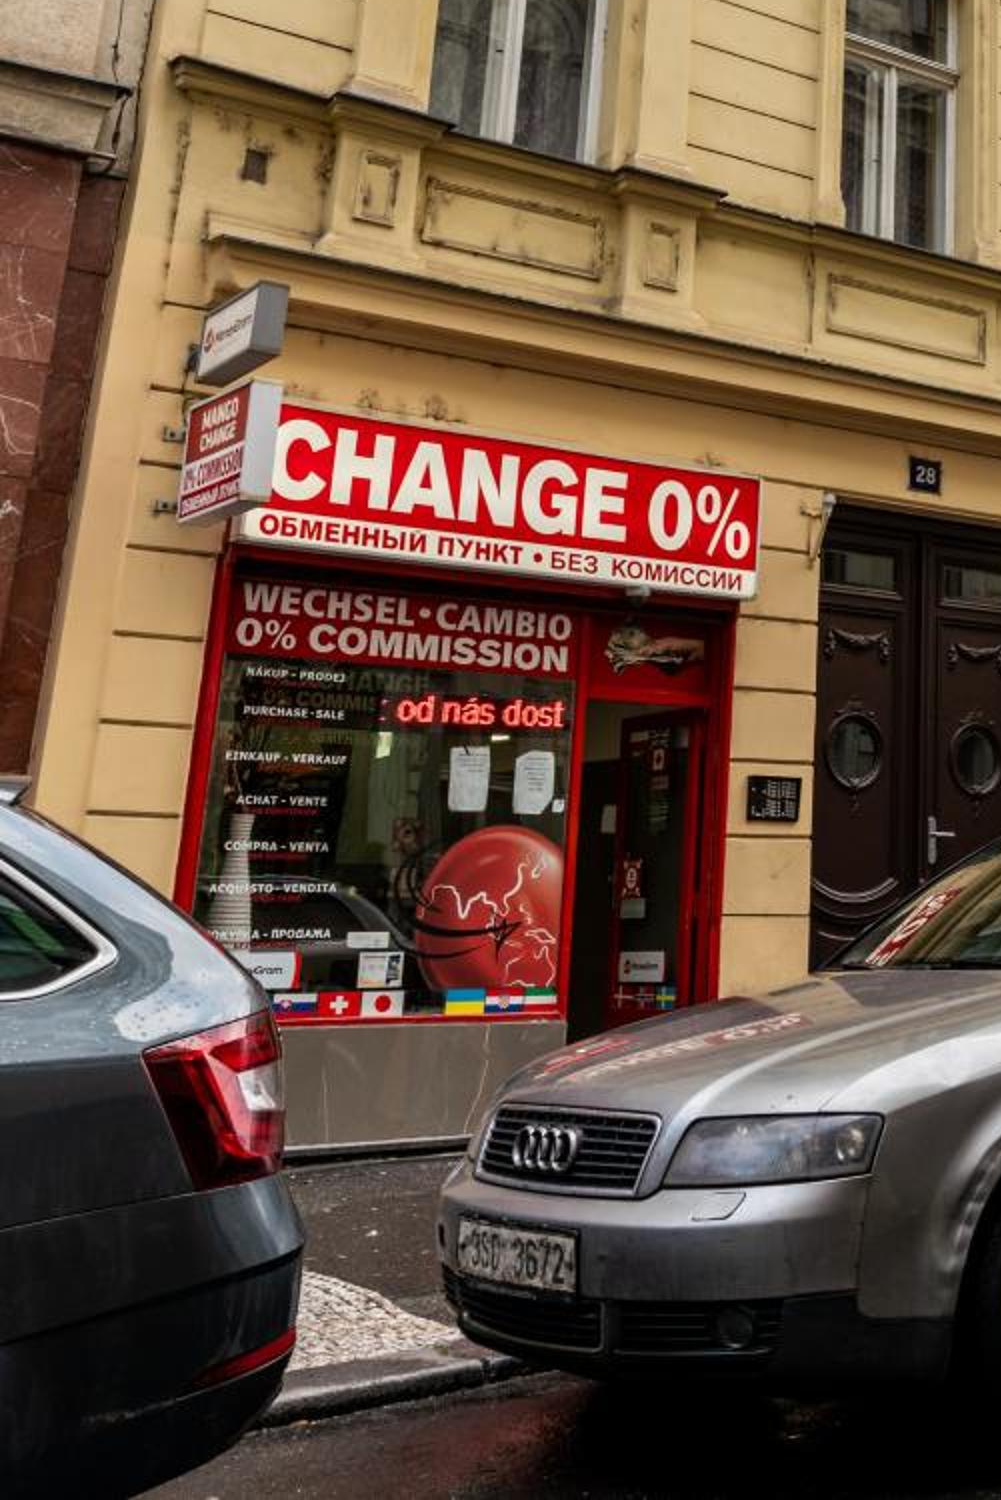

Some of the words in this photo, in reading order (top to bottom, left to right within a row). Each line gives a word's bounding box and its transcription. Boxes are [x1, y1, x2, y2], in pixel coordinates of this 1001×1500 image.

[202, 397, 239, 432] MANGO
[200, 420, 237, 452] CHANGE
[915, 465, 937, 485] 28
[271, 418, 629, 543] CHANGE
[648, 479, 750, 560] 0%
[259, 514, 427, 554] ОБМЕННЫЙ
[438, 536, 523, 565] ПУНКТ
[551, 551, 599, 574] БЕЗ
[611, 558, 742, 592] КОМИССИИ
[243, 581, 415, 627] WECHSEL
[435, 602, 573, 642] CAMBIO
[235, 617, 297, 650] 0%
[308, 623, 569, 673] COMMISSION
[245, 665, 289, 679] NÁKUP
[299, 670, 346, 683] PRODEJ
[243, 705, 309, 719] PURCHASE
[314, 710, 345, 721] SALE
[397, 695, 436, 723] od
[441, 697, 496, 726] nás
[502, 699, 565, 728] dost
[225, 751, 281, 763] EINKAUF
[292, 753, 348, 765] VERKAUF
[235, 795, 279, 806] ACHAT
[289, 796, 328, 807] VENTE
[224, 840, 278, 852] COMPRA
[289, 842, 329, 853] VENTA
[283, 883, 337, 893] VENDITA
[271, 928, 331, 940] ПРОДАЖА
[510, 1236, 566, 1285] 3672
